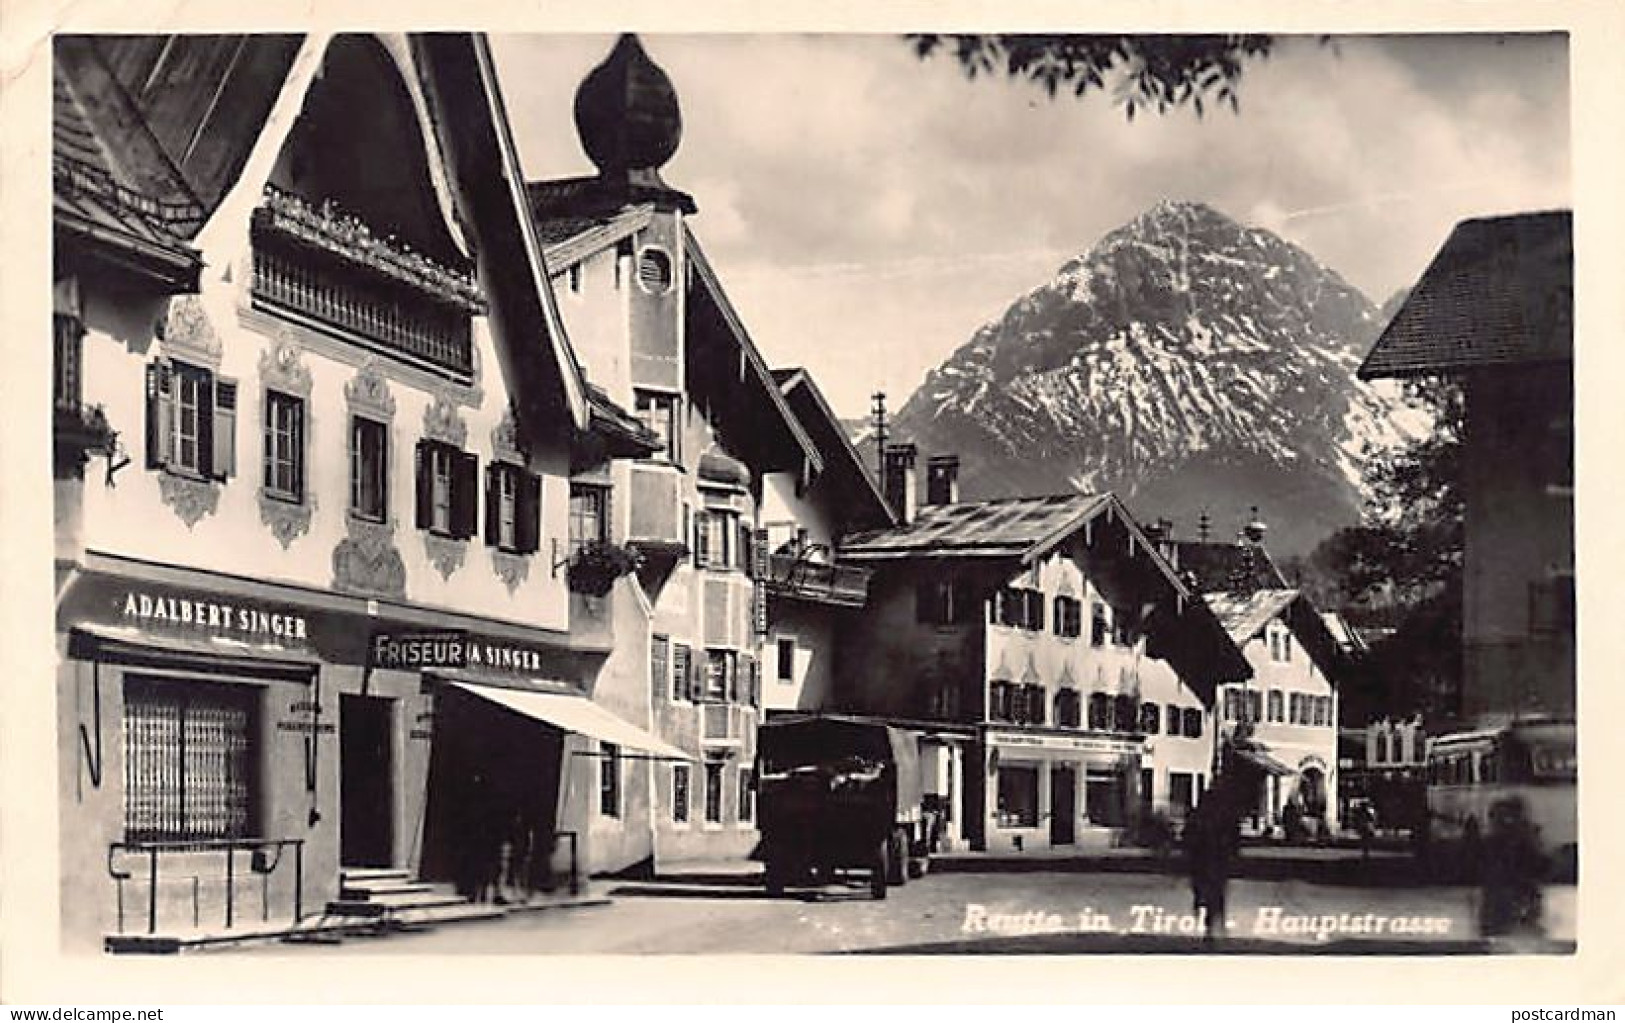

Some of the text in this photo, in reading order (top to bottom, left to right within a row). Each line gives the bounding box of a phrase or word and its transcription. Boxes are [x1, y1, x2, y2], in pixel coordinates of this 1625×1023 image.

[124, 592, 307, 639] ADALBERT SINGER
[376, 634, 461, 664] FRISEUR
[486, 645, 541, 671] SINGER
